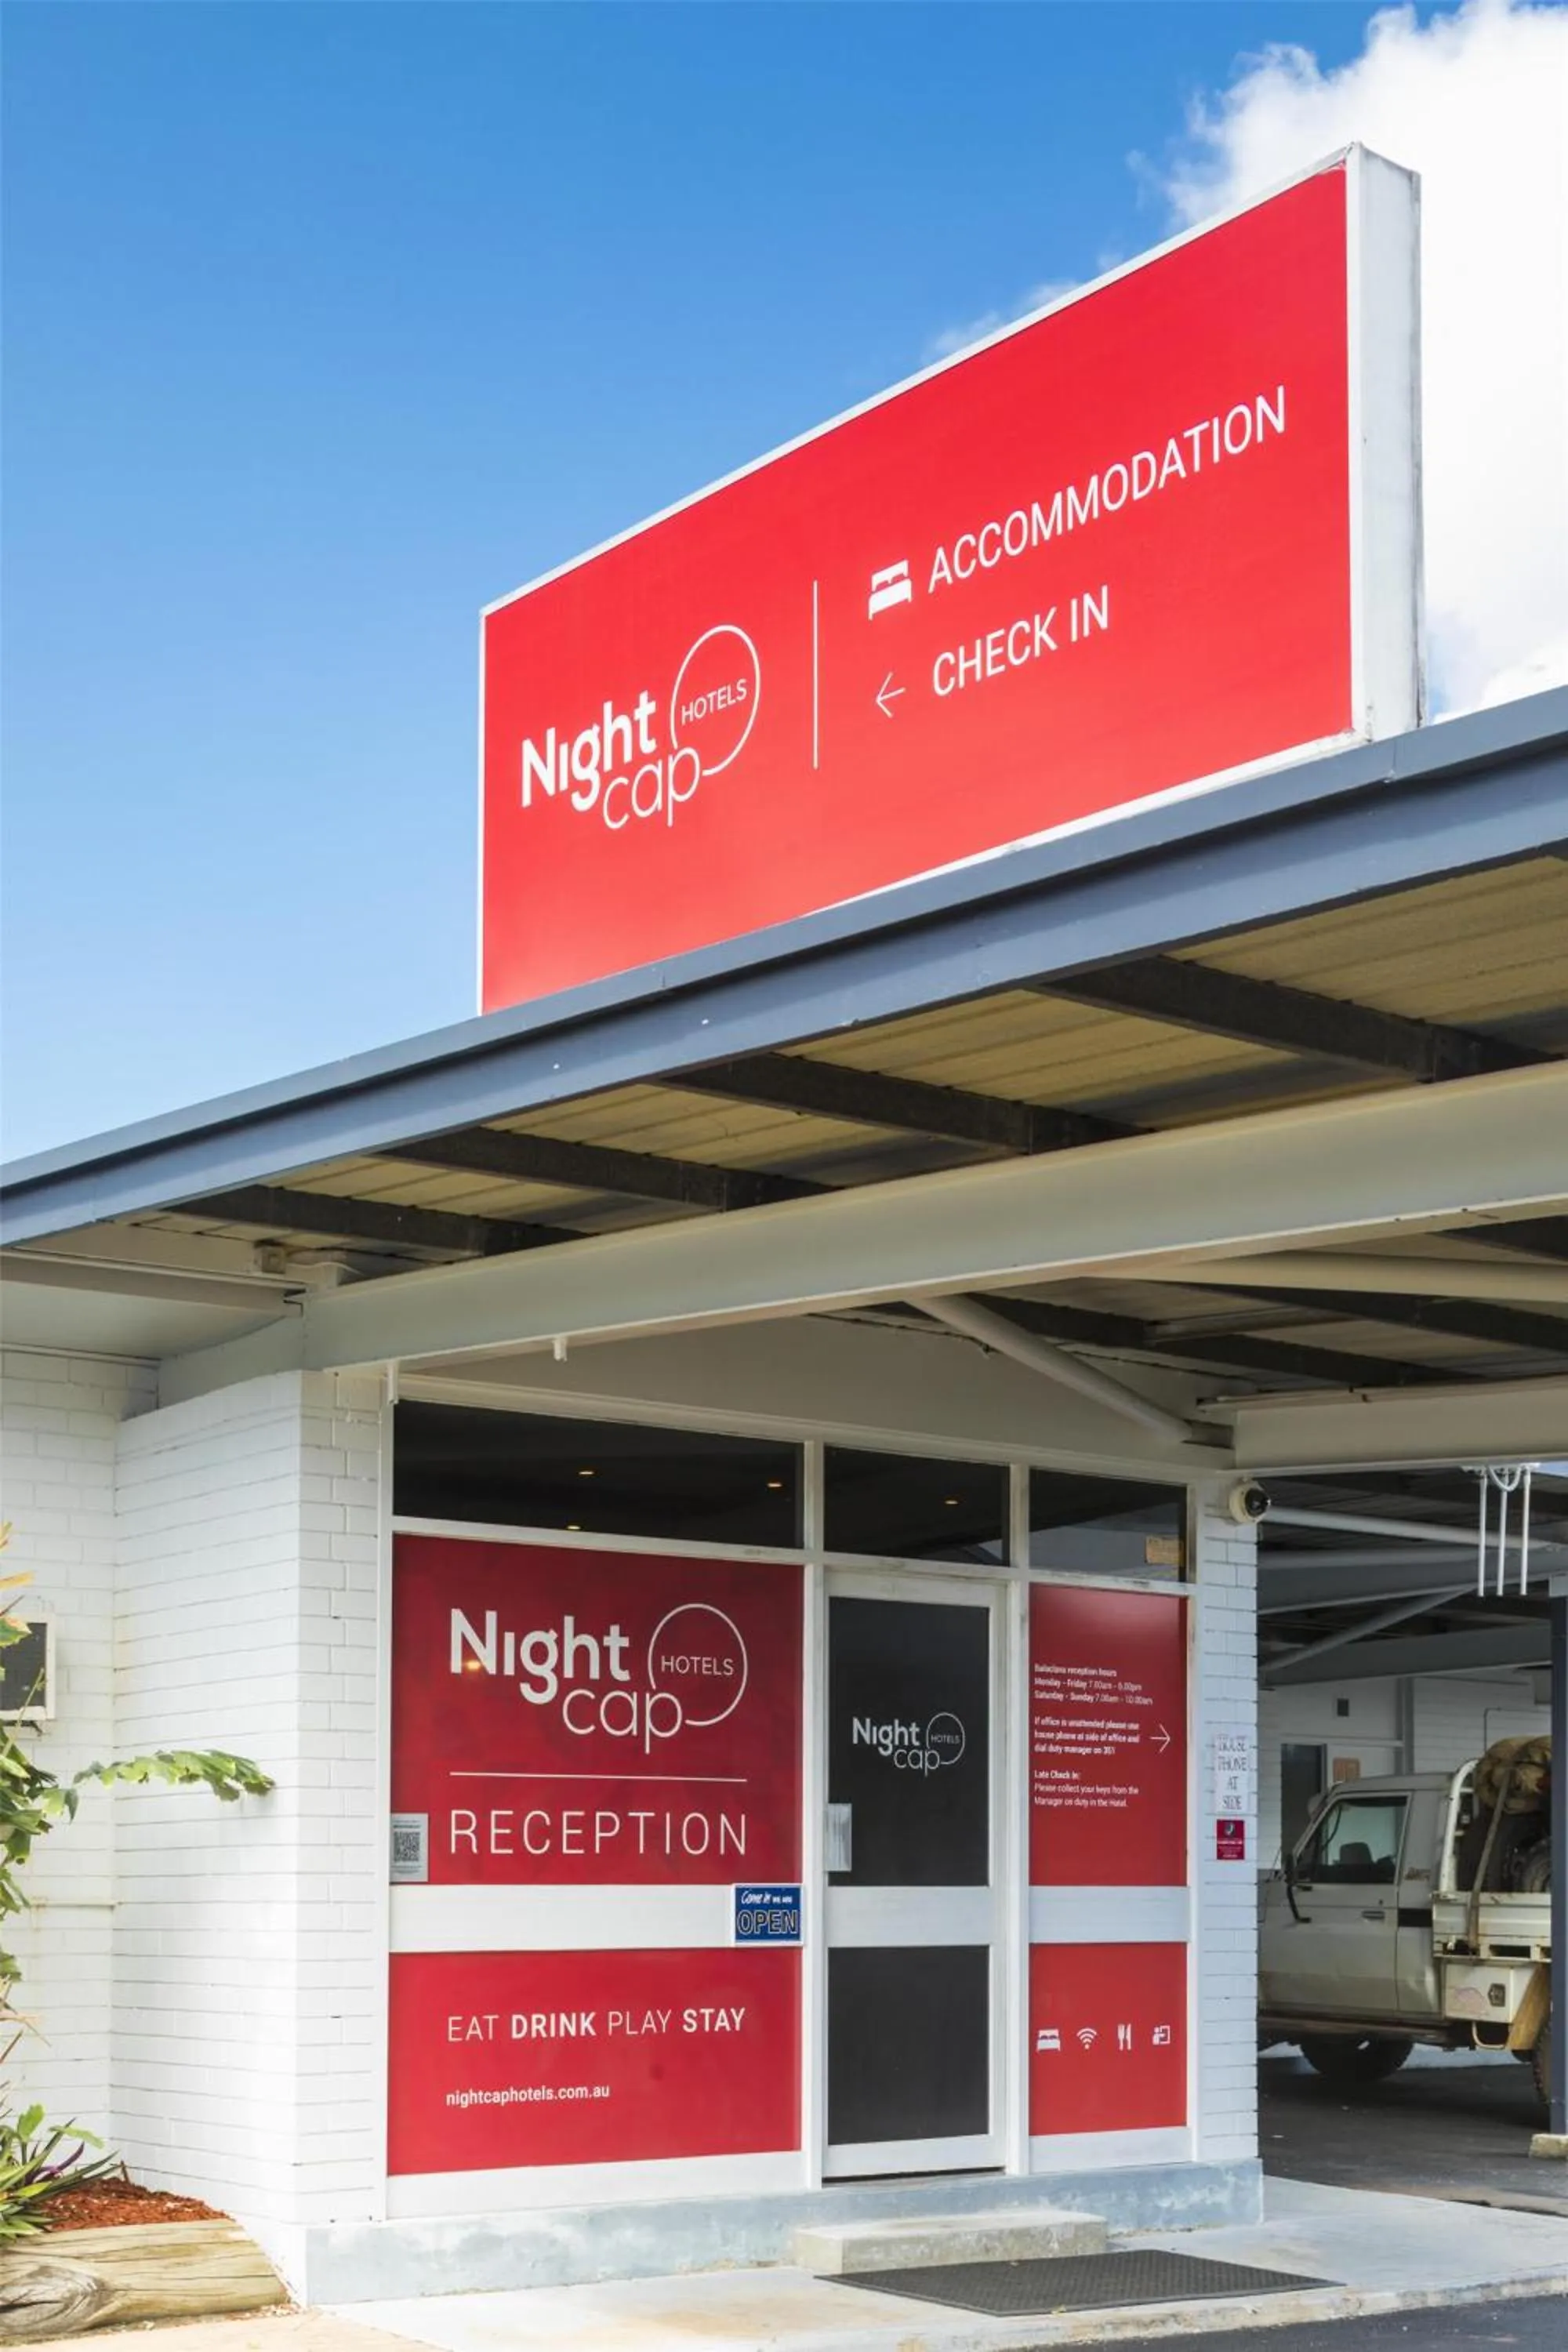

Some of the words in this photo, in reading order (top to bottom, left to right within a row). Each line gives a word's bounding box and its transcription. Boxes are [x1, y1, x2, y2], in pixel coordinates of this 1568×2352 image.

[927, 385, 1286, 593] ACCOMMODATION
[933, 607, 1058, 697] CHECK
[1071, 585, 1109, 642] IN
[681, 678, 748, 724] HOTELS
[521, 691, 657, 811] Night
[603, 746, 700, 829] cap
[450, 1608, 630, 1704] Night
[661, 1655, 734, 1676] HOTELS
[562, 1688, 682, 1755] cap
[852, 1717, 920, 1756] Night
[931, 1734, 960, 1744] HOTELS
[893, 1749, 940, 1777] cap
[1034, 1769, 1049, 1779] Late
[451, 1809, 746, 1855] RECEPTION
[737, 1909, 799, 1935] OPEN
[448, 2015, 499, 2042] EAT
[511, 2012, 596, 2039] DRINK
[608, 2009, 672, 2035] PLAY
[682, 2007, 746, 2033] STAY
[446, 2085, 610, 2108] nightcaphotels.com.au
